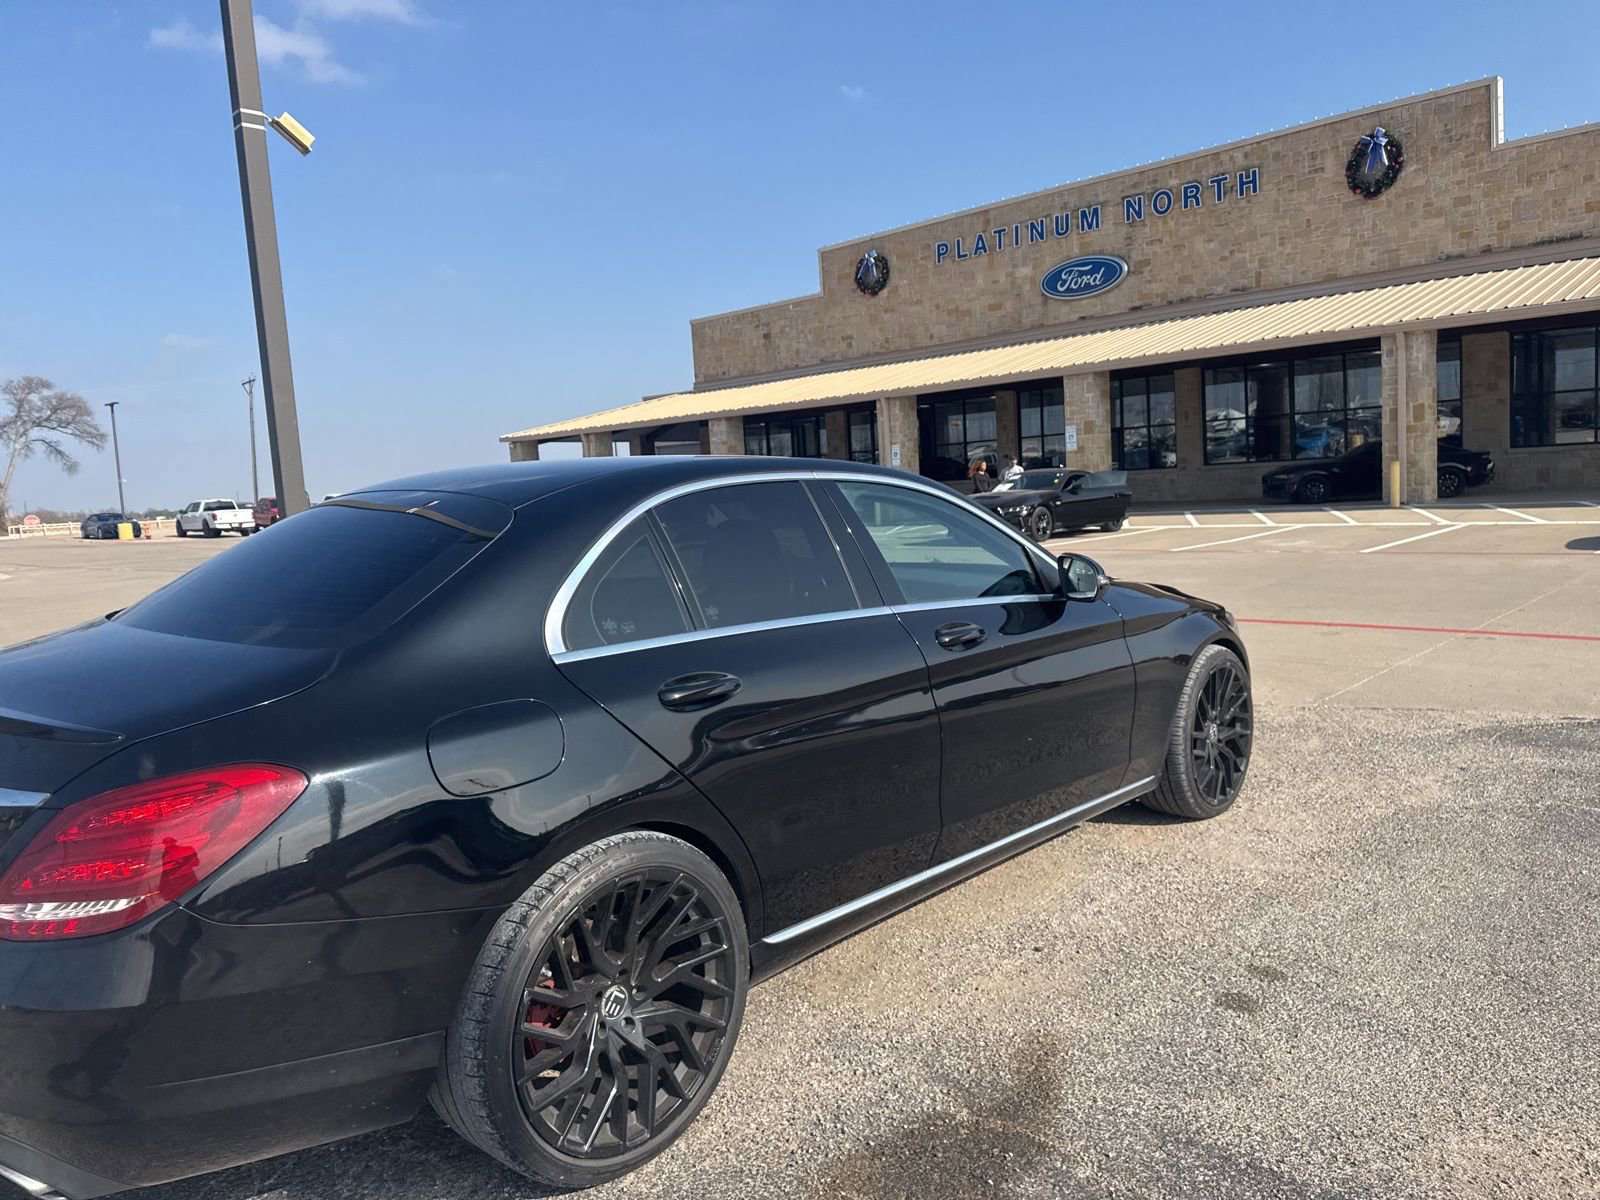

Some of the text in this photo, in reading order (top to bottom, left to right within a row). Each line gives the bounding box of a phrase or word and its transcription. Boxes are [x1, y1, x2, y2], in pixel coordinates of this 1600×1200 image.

[935, 167, 1260, 265] PLATINUM NORTH
[1057, 264, 1105, 292] Ford
